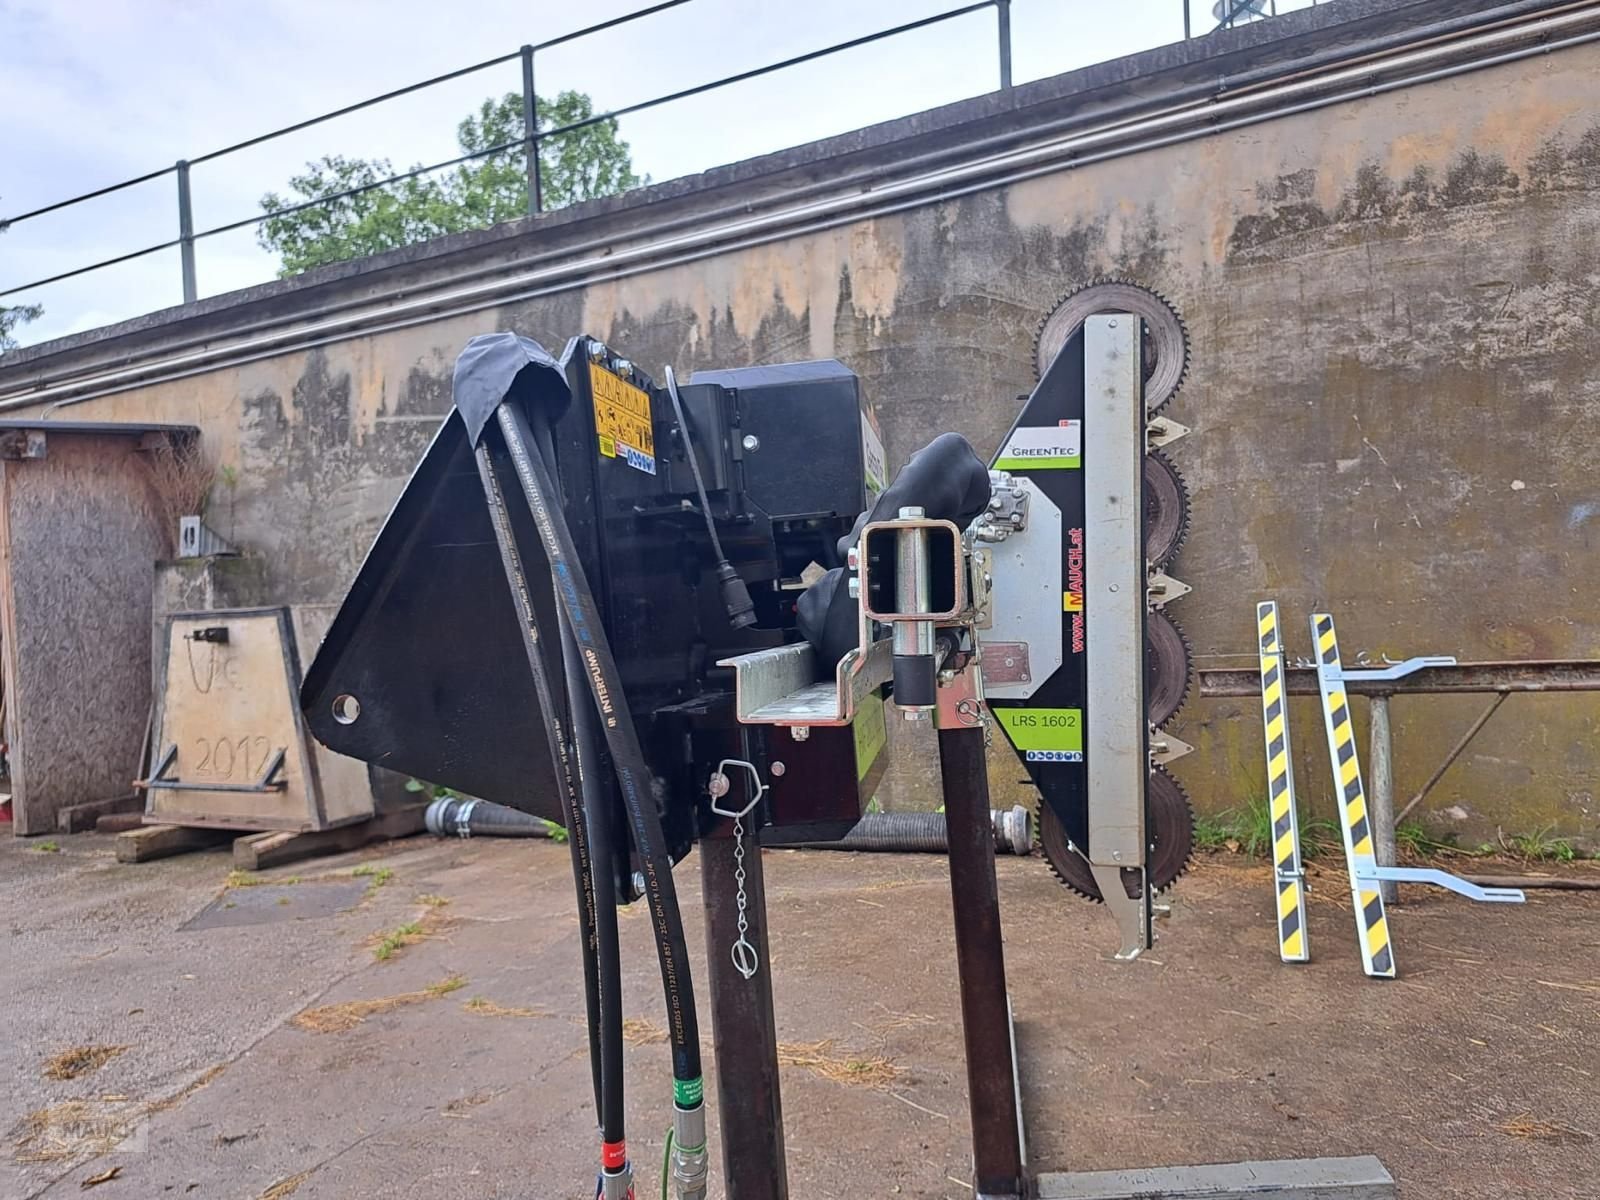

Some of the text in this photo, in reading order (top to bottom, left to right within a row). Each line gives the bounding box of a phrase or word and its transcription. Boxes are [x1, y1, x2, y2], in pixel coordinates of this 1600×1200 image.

[585, 649, 613, 713] INTERPUMP
[1012, 715, 1076, 728] LRS 1602
[655, 904, 664, 917] DN
[671, 995, 680, 1008] ISO
[674, 1010, 684, 1045] EXCEEDS
